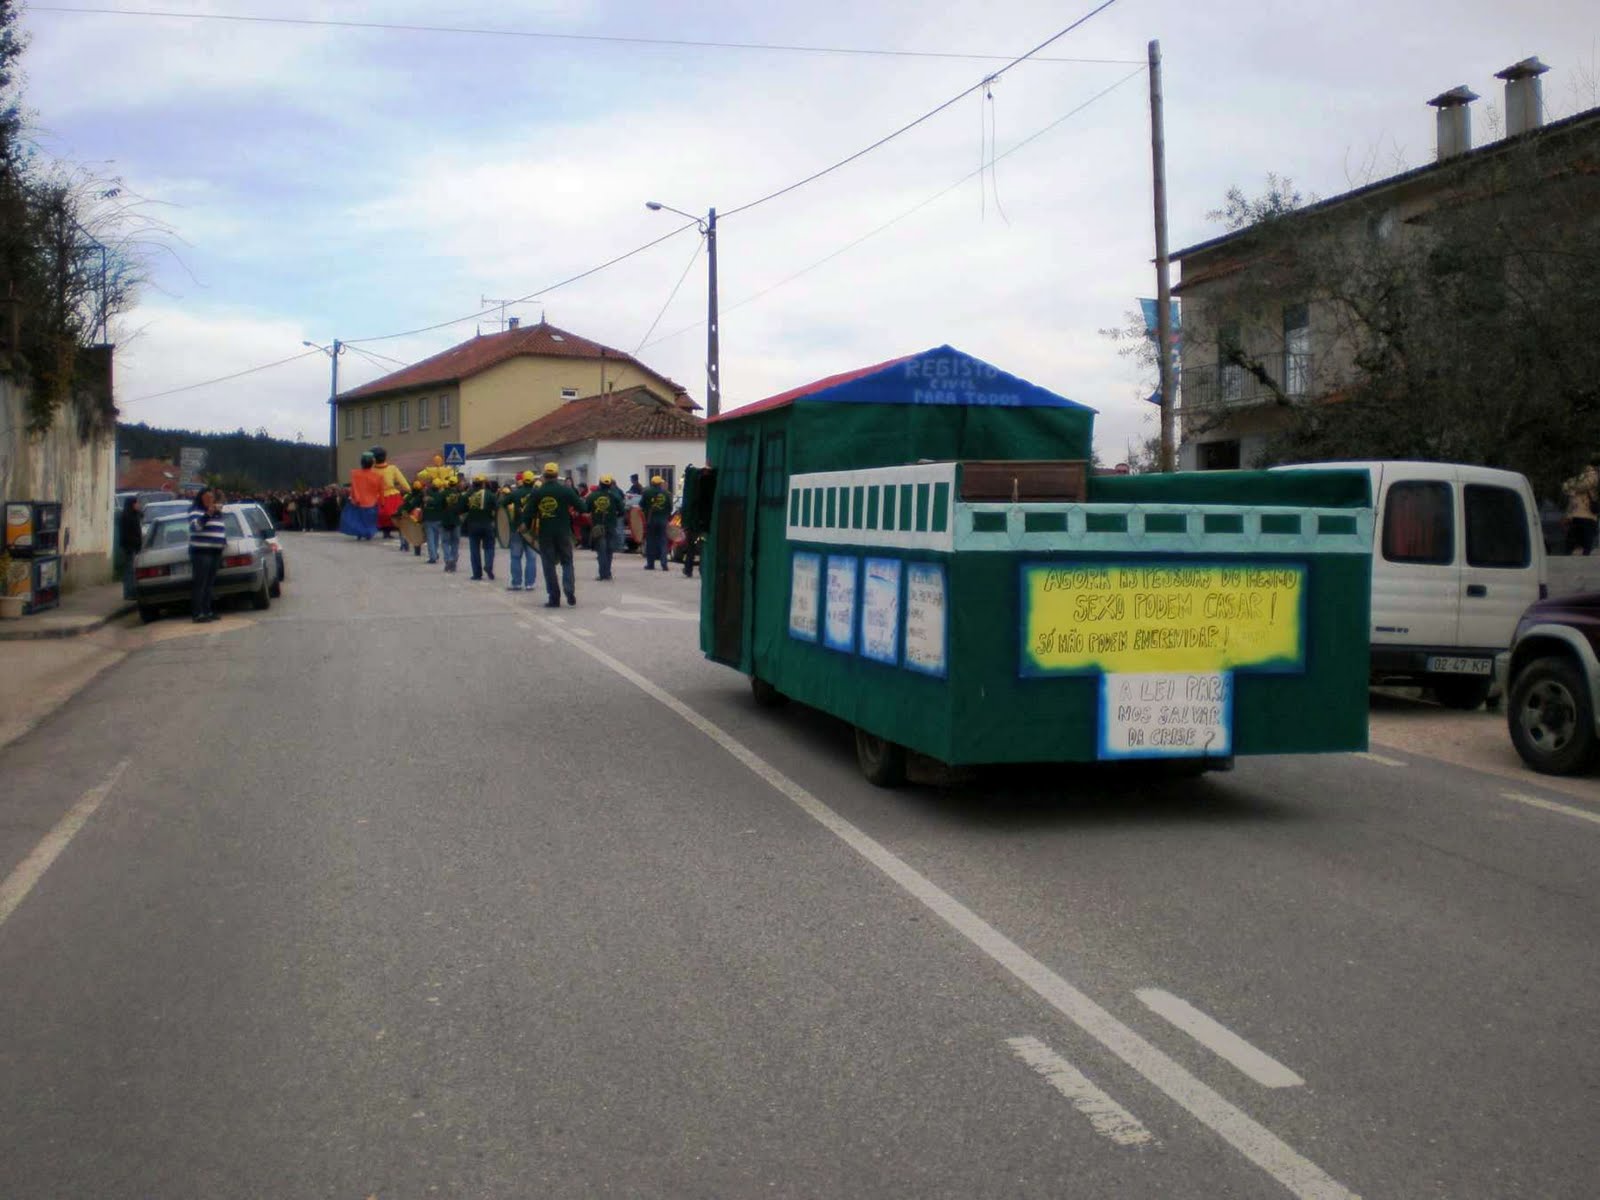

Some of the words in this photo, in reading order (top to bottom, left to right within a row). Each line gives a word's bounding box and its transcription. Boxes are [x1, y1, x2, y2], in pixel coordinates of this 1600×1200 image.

[906, 357, 996, 379] REGISTO
[913, 388, 957, 404] PARA
[964, 391, 1021, 406] TODOS
[1044, 568, 1112, 592] AGORA
[1143, 568, 1212, 589] PESSOAS
[1221, 567, 1242, 588] DO
[1246, 567, 1298, 590] MESMO
[1072, 592, 1125, 622] SEXO
[1134, 591, 1193, 621] PODEM
[1036, 627, 1057, 655] SÓ
[1058, 628, 1084, 654] NÃO
[1088, 629, 1129, 654] PODEM
[1119, 680, 1133, 702] A
[1140, 679, 1175, 702] LEI
[1118, 705, 1153, 725] NOS
[1157, 705, 1220, 726] SALVAR
